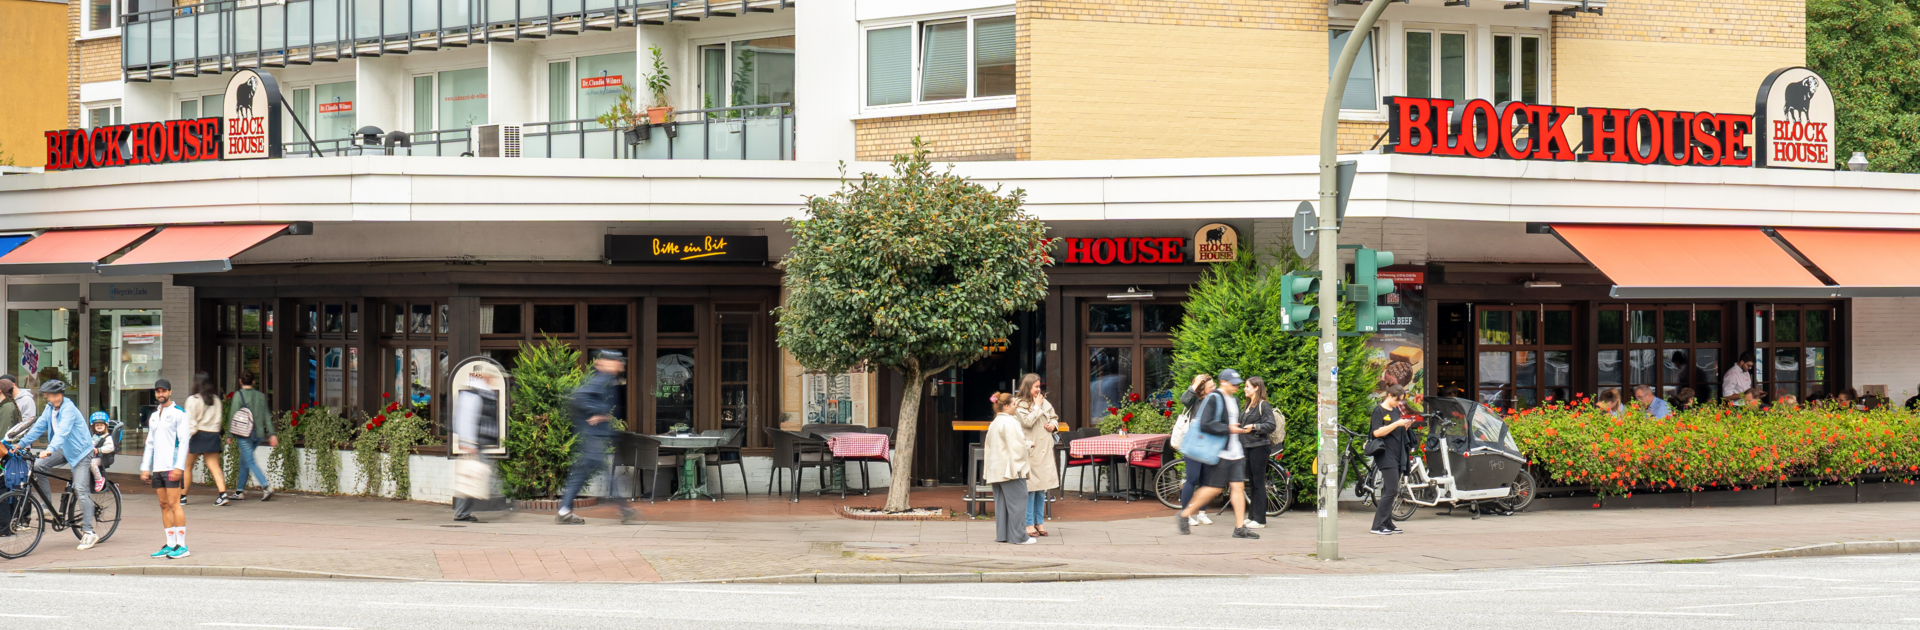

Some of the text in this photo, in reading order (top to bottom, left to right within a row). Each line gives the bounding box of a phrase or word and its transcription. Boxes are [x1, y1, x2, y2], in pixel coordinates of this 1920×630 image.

[228, 117, 264, 136] BLOCK
[1394, 97, 1752, 167] BLOCK HOUSE
[1773, 120, 1828, 143] BLOCK
[45, 117, 219, 171] BLOCK HOUSE
[228, 136, 264, 154] HOUSE
[1773, 141, 1828, 164] HOUSE
[653, 235, 728, 256] Bitte ein Bit
[1064, 237, 1184, 264] HOUSE
[1199, 243, 1233, 252] BLOCK
[1199, 251, 1234, 260] HOUSE
[1397, 317, 1412, 325] BEEF
